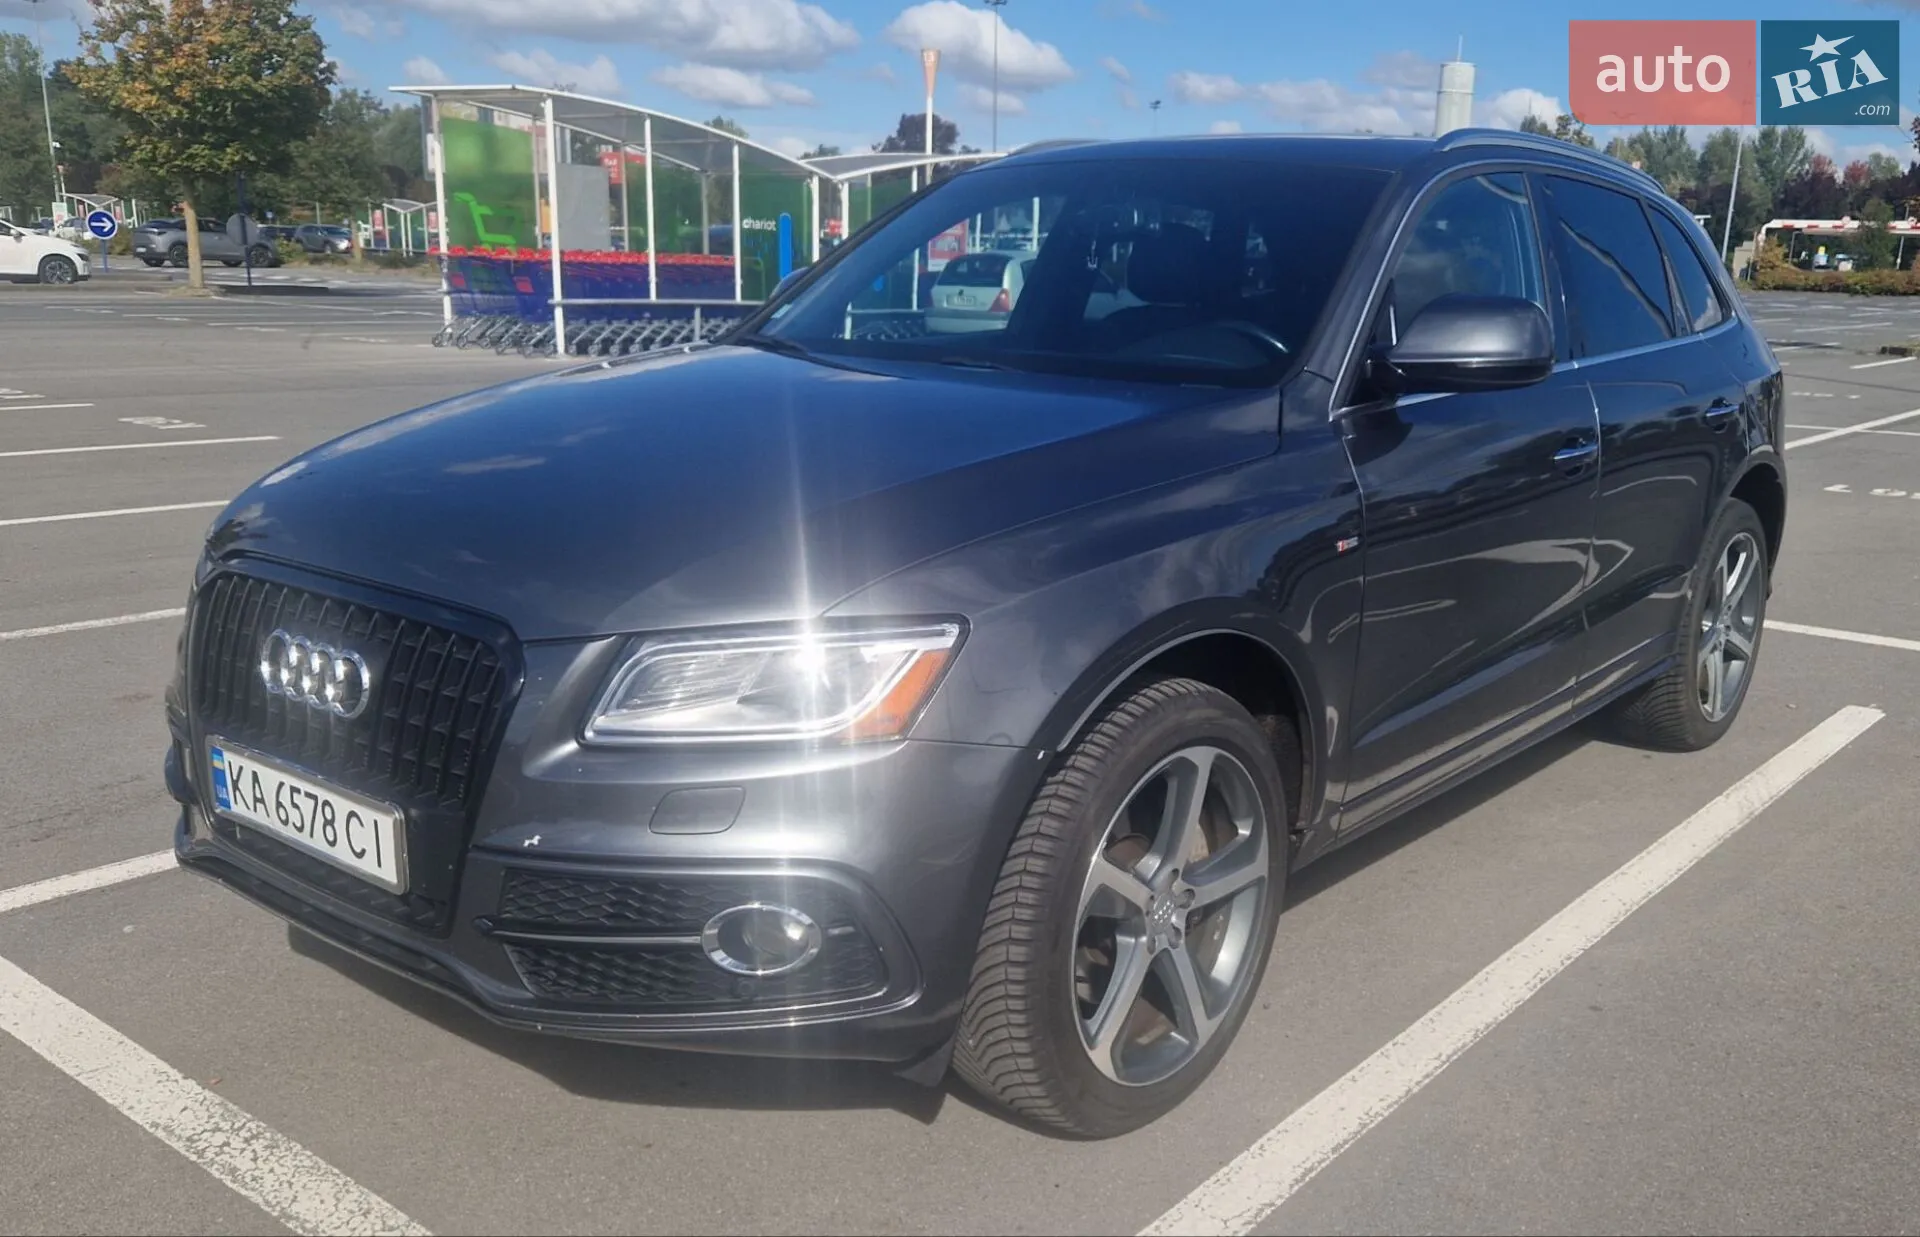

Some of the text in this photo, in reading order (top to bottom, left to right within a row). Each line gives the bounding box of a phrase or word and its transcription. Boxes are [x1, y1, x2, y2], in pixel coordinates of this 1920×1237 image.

[742, 216, 777, 231] chariot
[228, 760, 382, 869] KA 6578 CI
